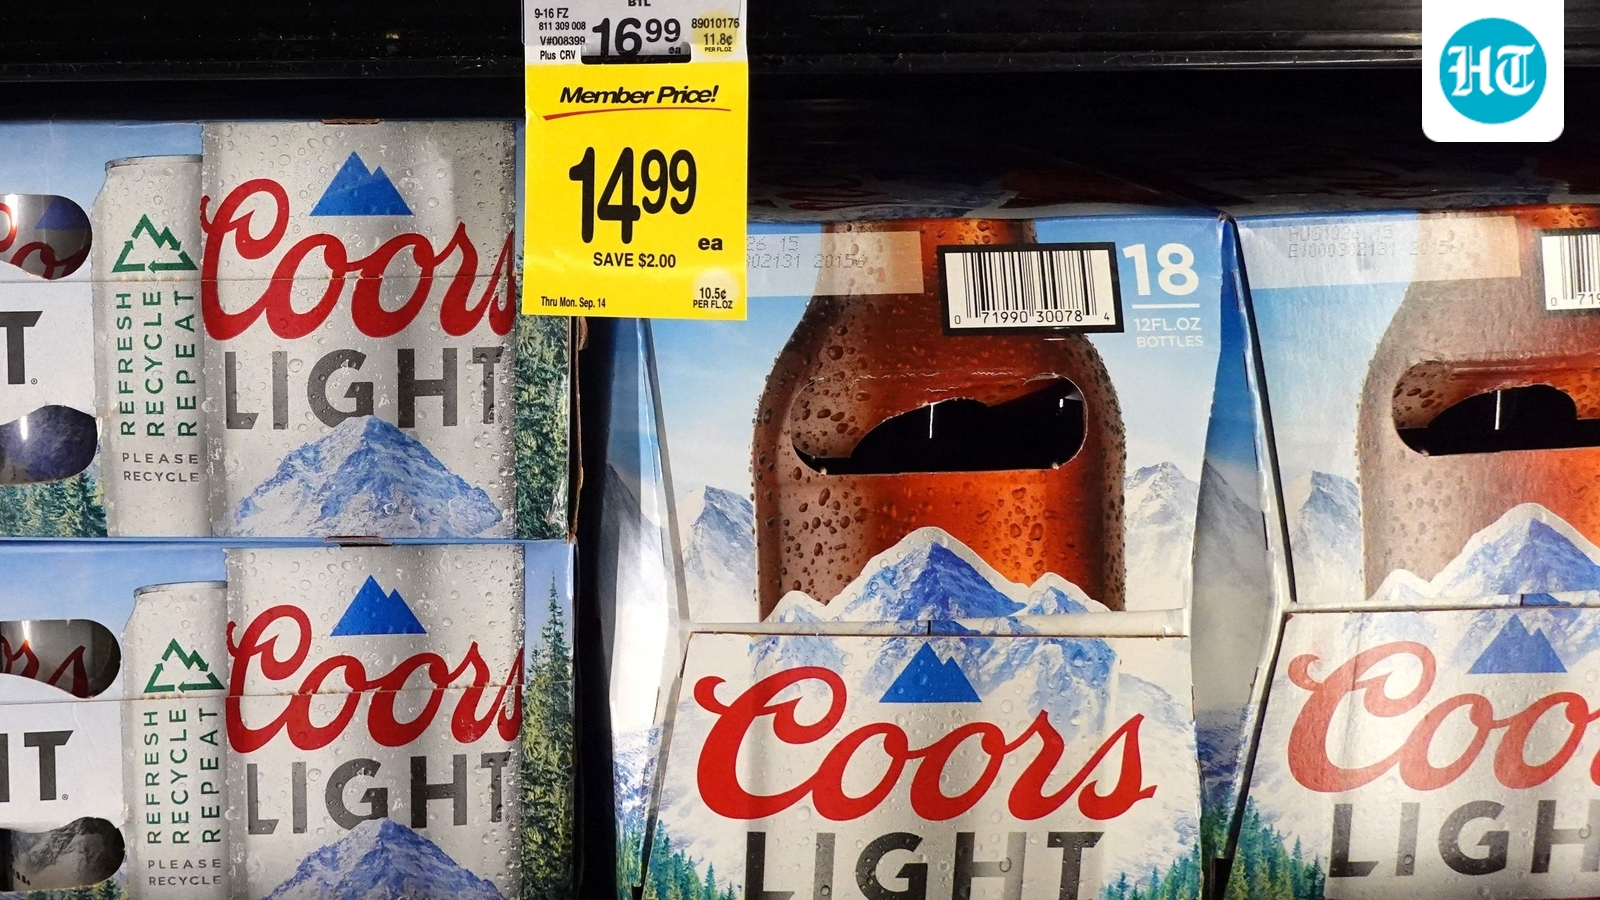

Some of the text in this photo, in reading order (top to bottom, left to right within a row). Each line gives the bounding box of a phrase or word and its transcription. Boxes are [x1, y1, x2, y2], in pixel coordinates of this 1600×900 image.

[534, 8, 569, 18] 9-16 FZ
[538, 22, 586, 30] 811 309 008
[691, 18, 740, 28] 89010176
[540, 36, 586, 45] V#008399
[703, 34, 733, 45] 11.8¢
[540, 51, 576, 60] Plus CRV
[668, 46, 682, 55] ea
[559, 85, 720, 104] Member Price!
[697, 237, 723, 251] ea
[200, 178, 516, 341] Coors
[593, 252, 676, 269] SAVE $2.00
[1122, 243, 1199, 296] 18
[699, 287, 727, 299] 10.5¢
[541, 296, 606, 309] Thru Mon. Sep. 14
[693, 300, 709, 309] PER
[954, 309, 1110, 325] 0 71990 30078 4
[1136, 335, 1204, 348] BOTTLES
[116, 292, 136, 436] REFRESH
[143, 290, 165, 437] RECYCLE
[174, 289, 198, 437] REPEAT
[225, 346, 504, 430] LIGHT
[122, 452, 199, 465] PLEASE
[124, 470, 199, 483] RECYCLE
[225, 604, 524, 753] Coors
[1287, 641, 1600, 793] Coo
[693, 666, 1158, 821] Coors
[143, 711, 162, 844] REFRESH
[169, 708, 190, 844] RECYCLE
[199, 707, 221, 843] REPEAT
[247, 751, 512, 836] LIGHT
[148, 858, 222, 870] PLEASE
[746, 831, 1105, 900] LIGHT
[149, 875, 222, 886] RECYCLE
